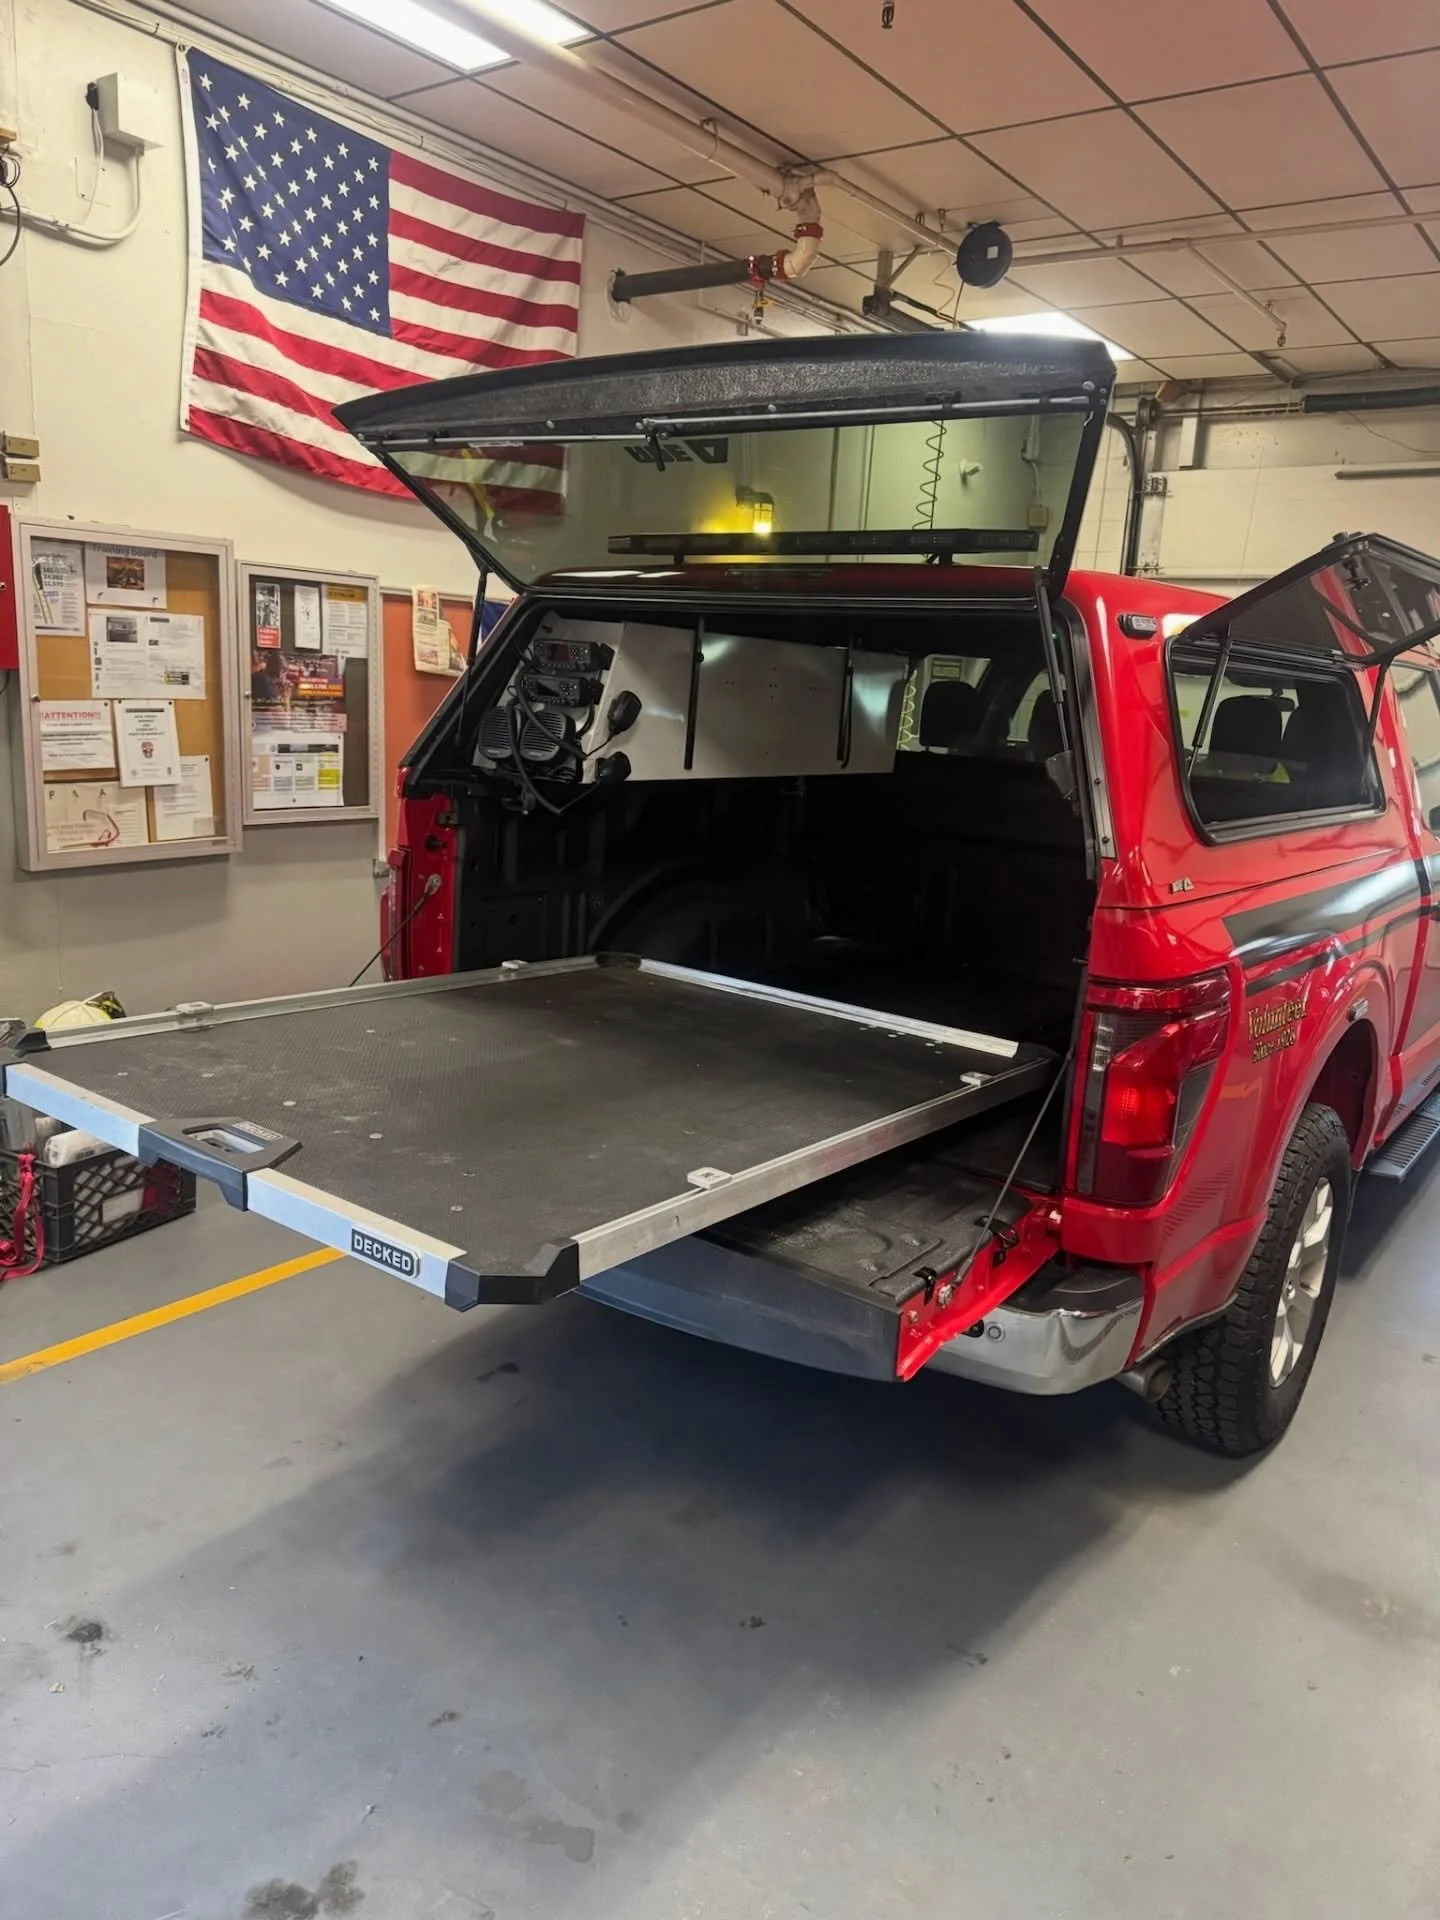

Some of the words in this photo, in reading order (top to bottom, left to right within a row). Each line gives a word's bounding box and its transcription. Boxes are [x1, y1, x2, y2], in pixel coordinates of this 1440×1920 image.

[93, 543, 130, 557] Training
[131, 547, 158, 559] board
[1248, 999, 1307, 1041] Volunteer
[353, 1234, 412, 1272] DECKED
